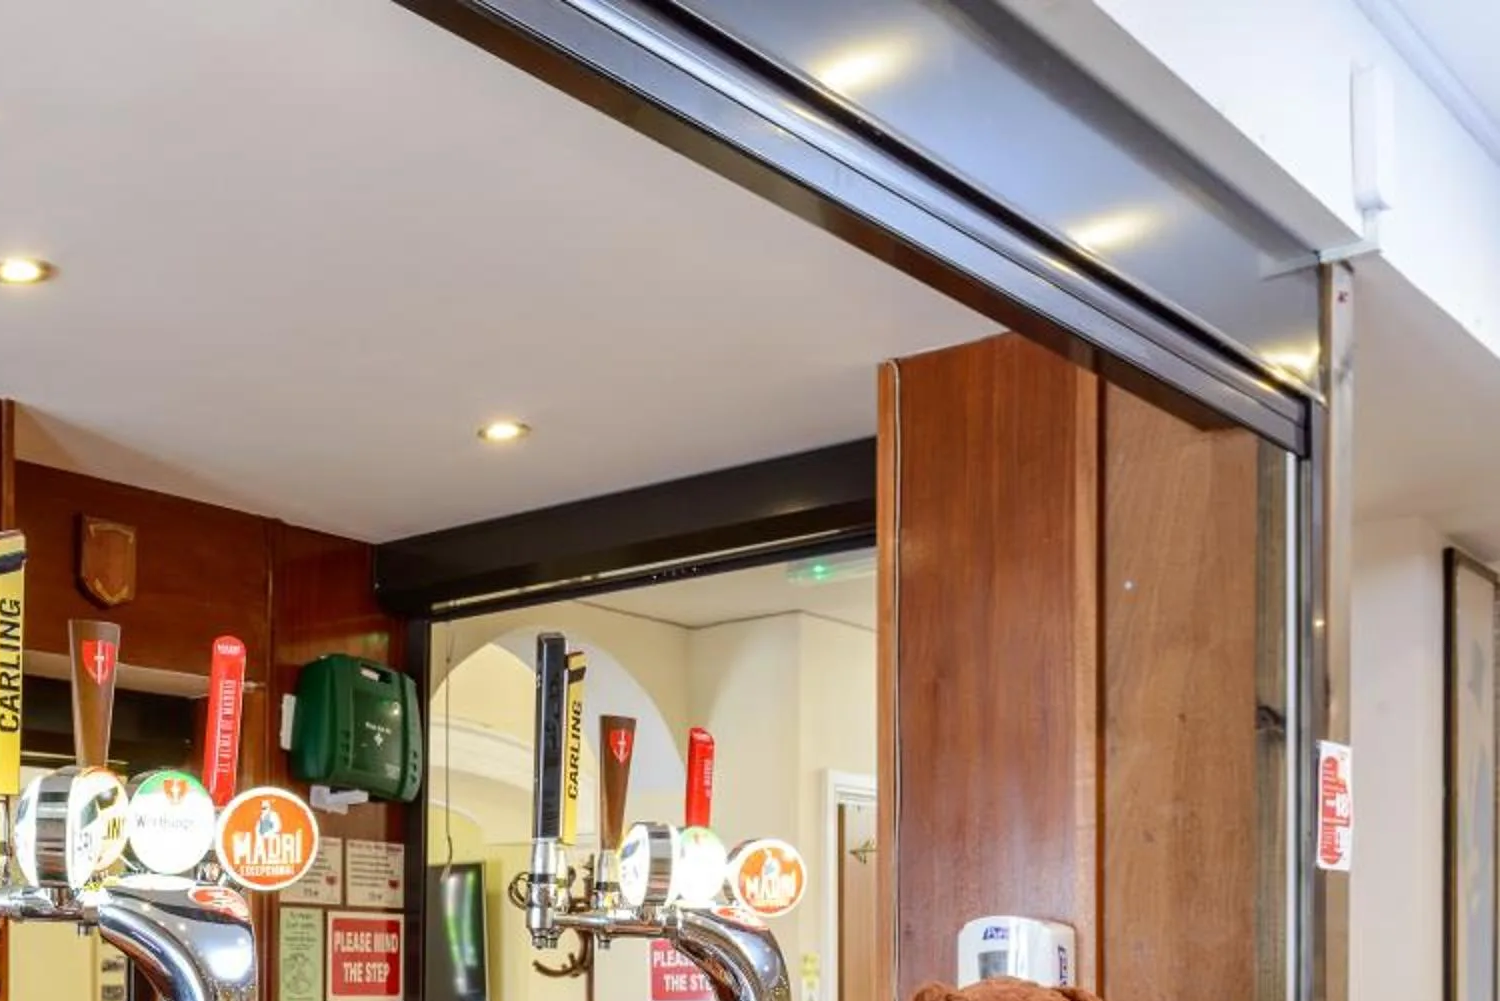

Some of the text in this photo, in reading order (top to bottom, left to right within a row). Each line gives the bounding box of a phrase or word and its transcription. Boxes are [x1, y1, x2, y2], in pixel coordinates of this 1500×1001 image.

[567, 700, 583, 800] CARLING
[333, 930, 373, 953] PLEASE
[343, 961, 391, 984] THE STEP
[663, 973, 689, 993] THE
